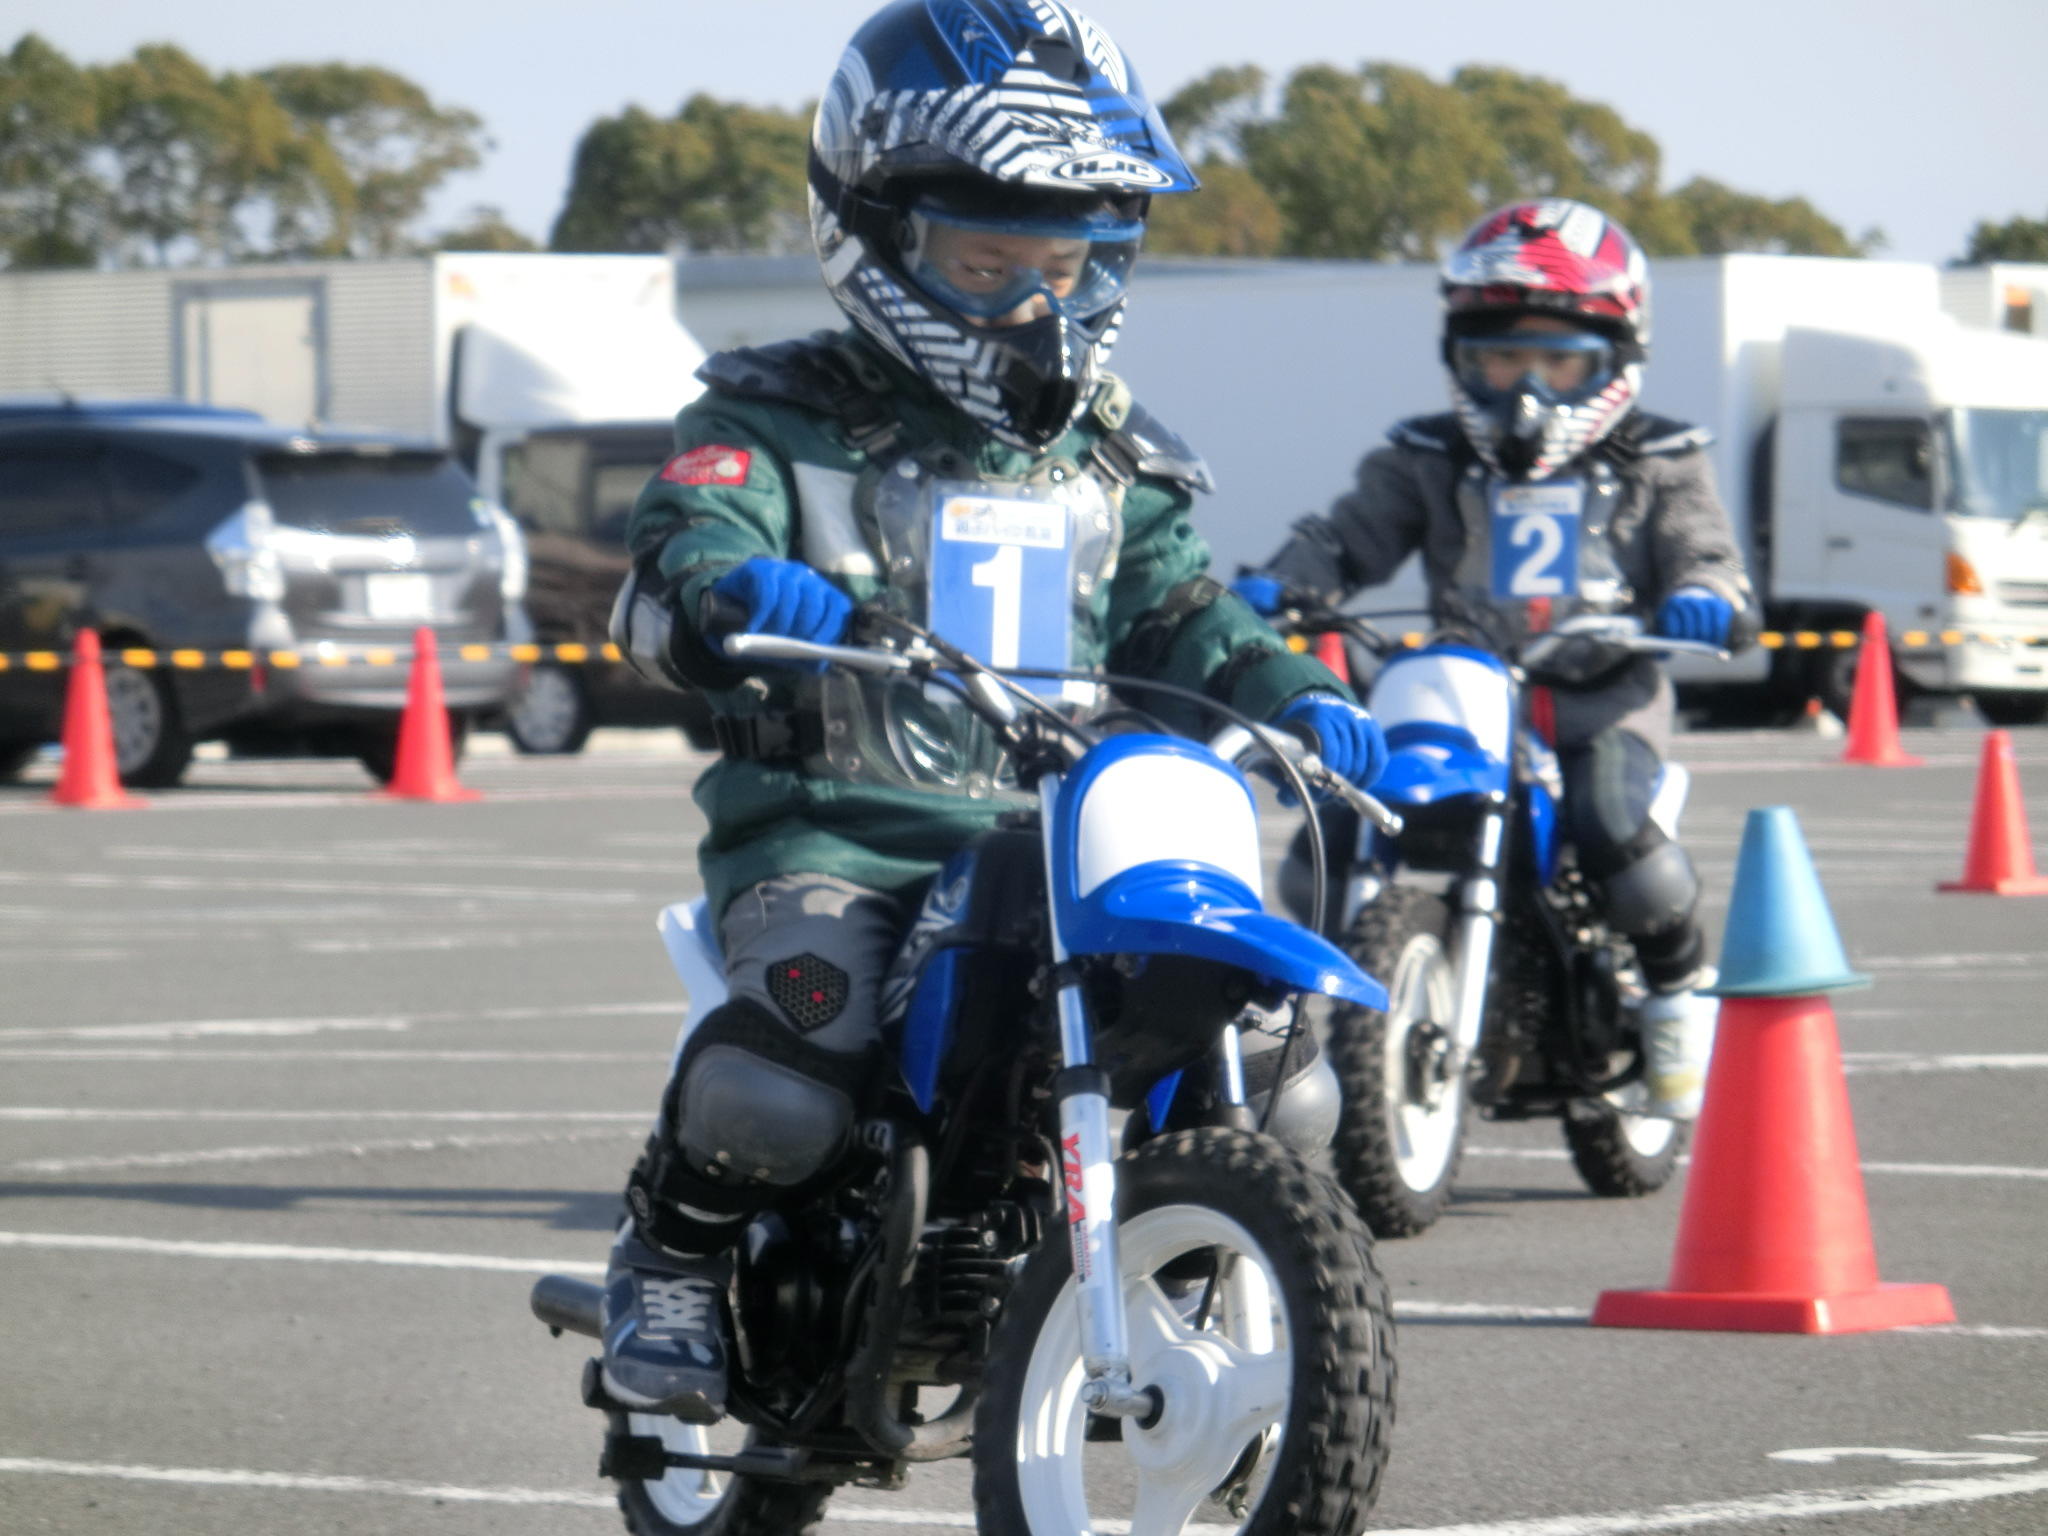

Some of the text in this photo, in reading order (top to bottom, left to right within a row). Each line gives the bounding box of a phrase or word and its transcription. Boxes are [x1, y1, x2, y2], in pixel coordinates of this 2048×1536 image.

[1070, 160, 1150, 178] HJC
[1510, 514, 1563, 595] 2
[972, 544, 1023, 669] 1
[1062, 1132, 1086, 1225] YRA
